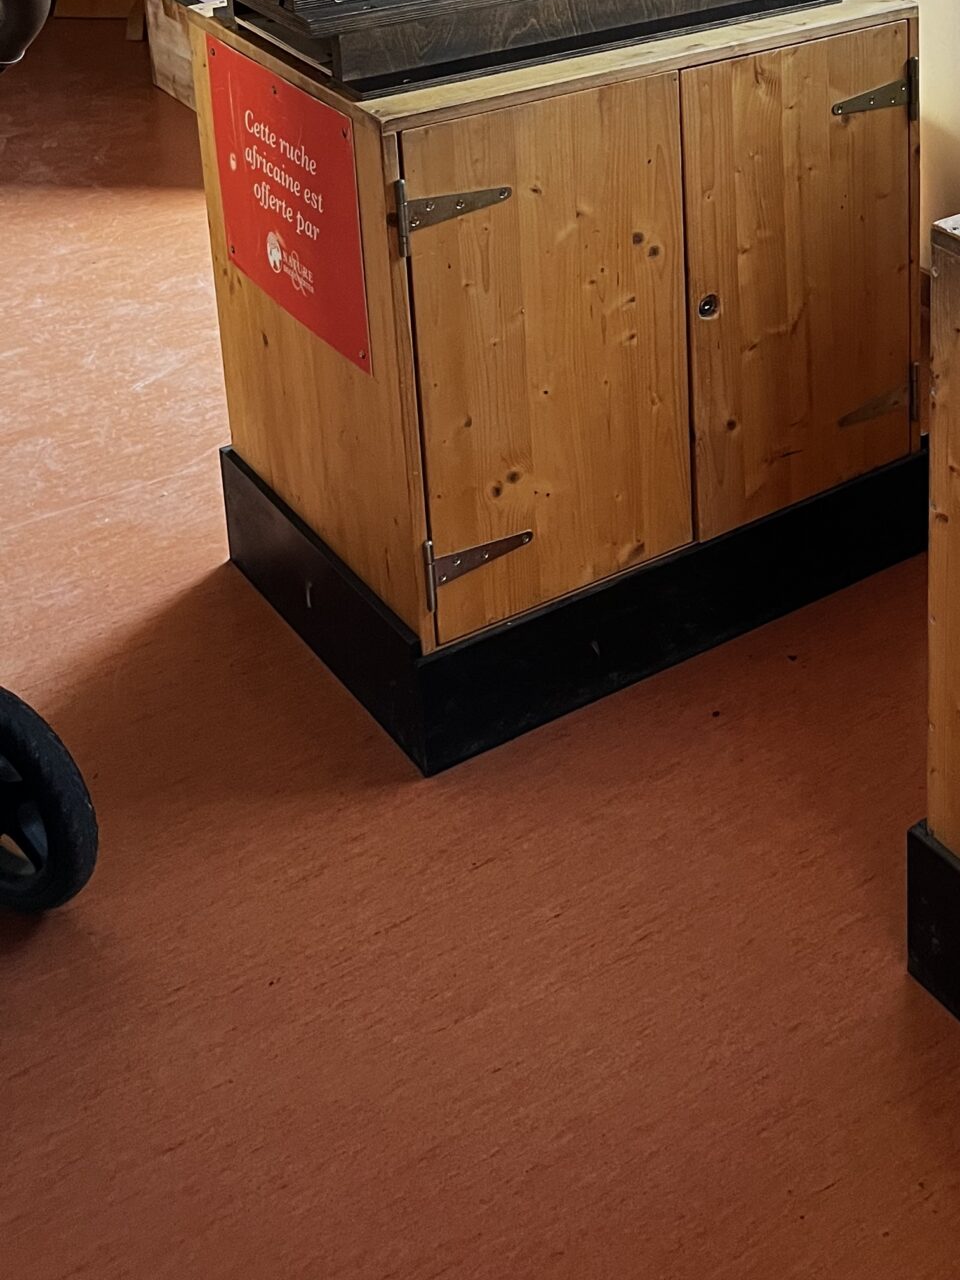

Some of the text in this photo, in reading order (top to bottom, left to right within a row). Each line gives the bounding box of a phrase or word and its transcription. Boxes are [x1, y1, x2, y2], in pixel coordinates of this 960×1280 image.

[244, 109, 317, 175] Cette ruche
[245, 145, 323, 213] africaine est
[253, 181, 320, 240] offerte par
